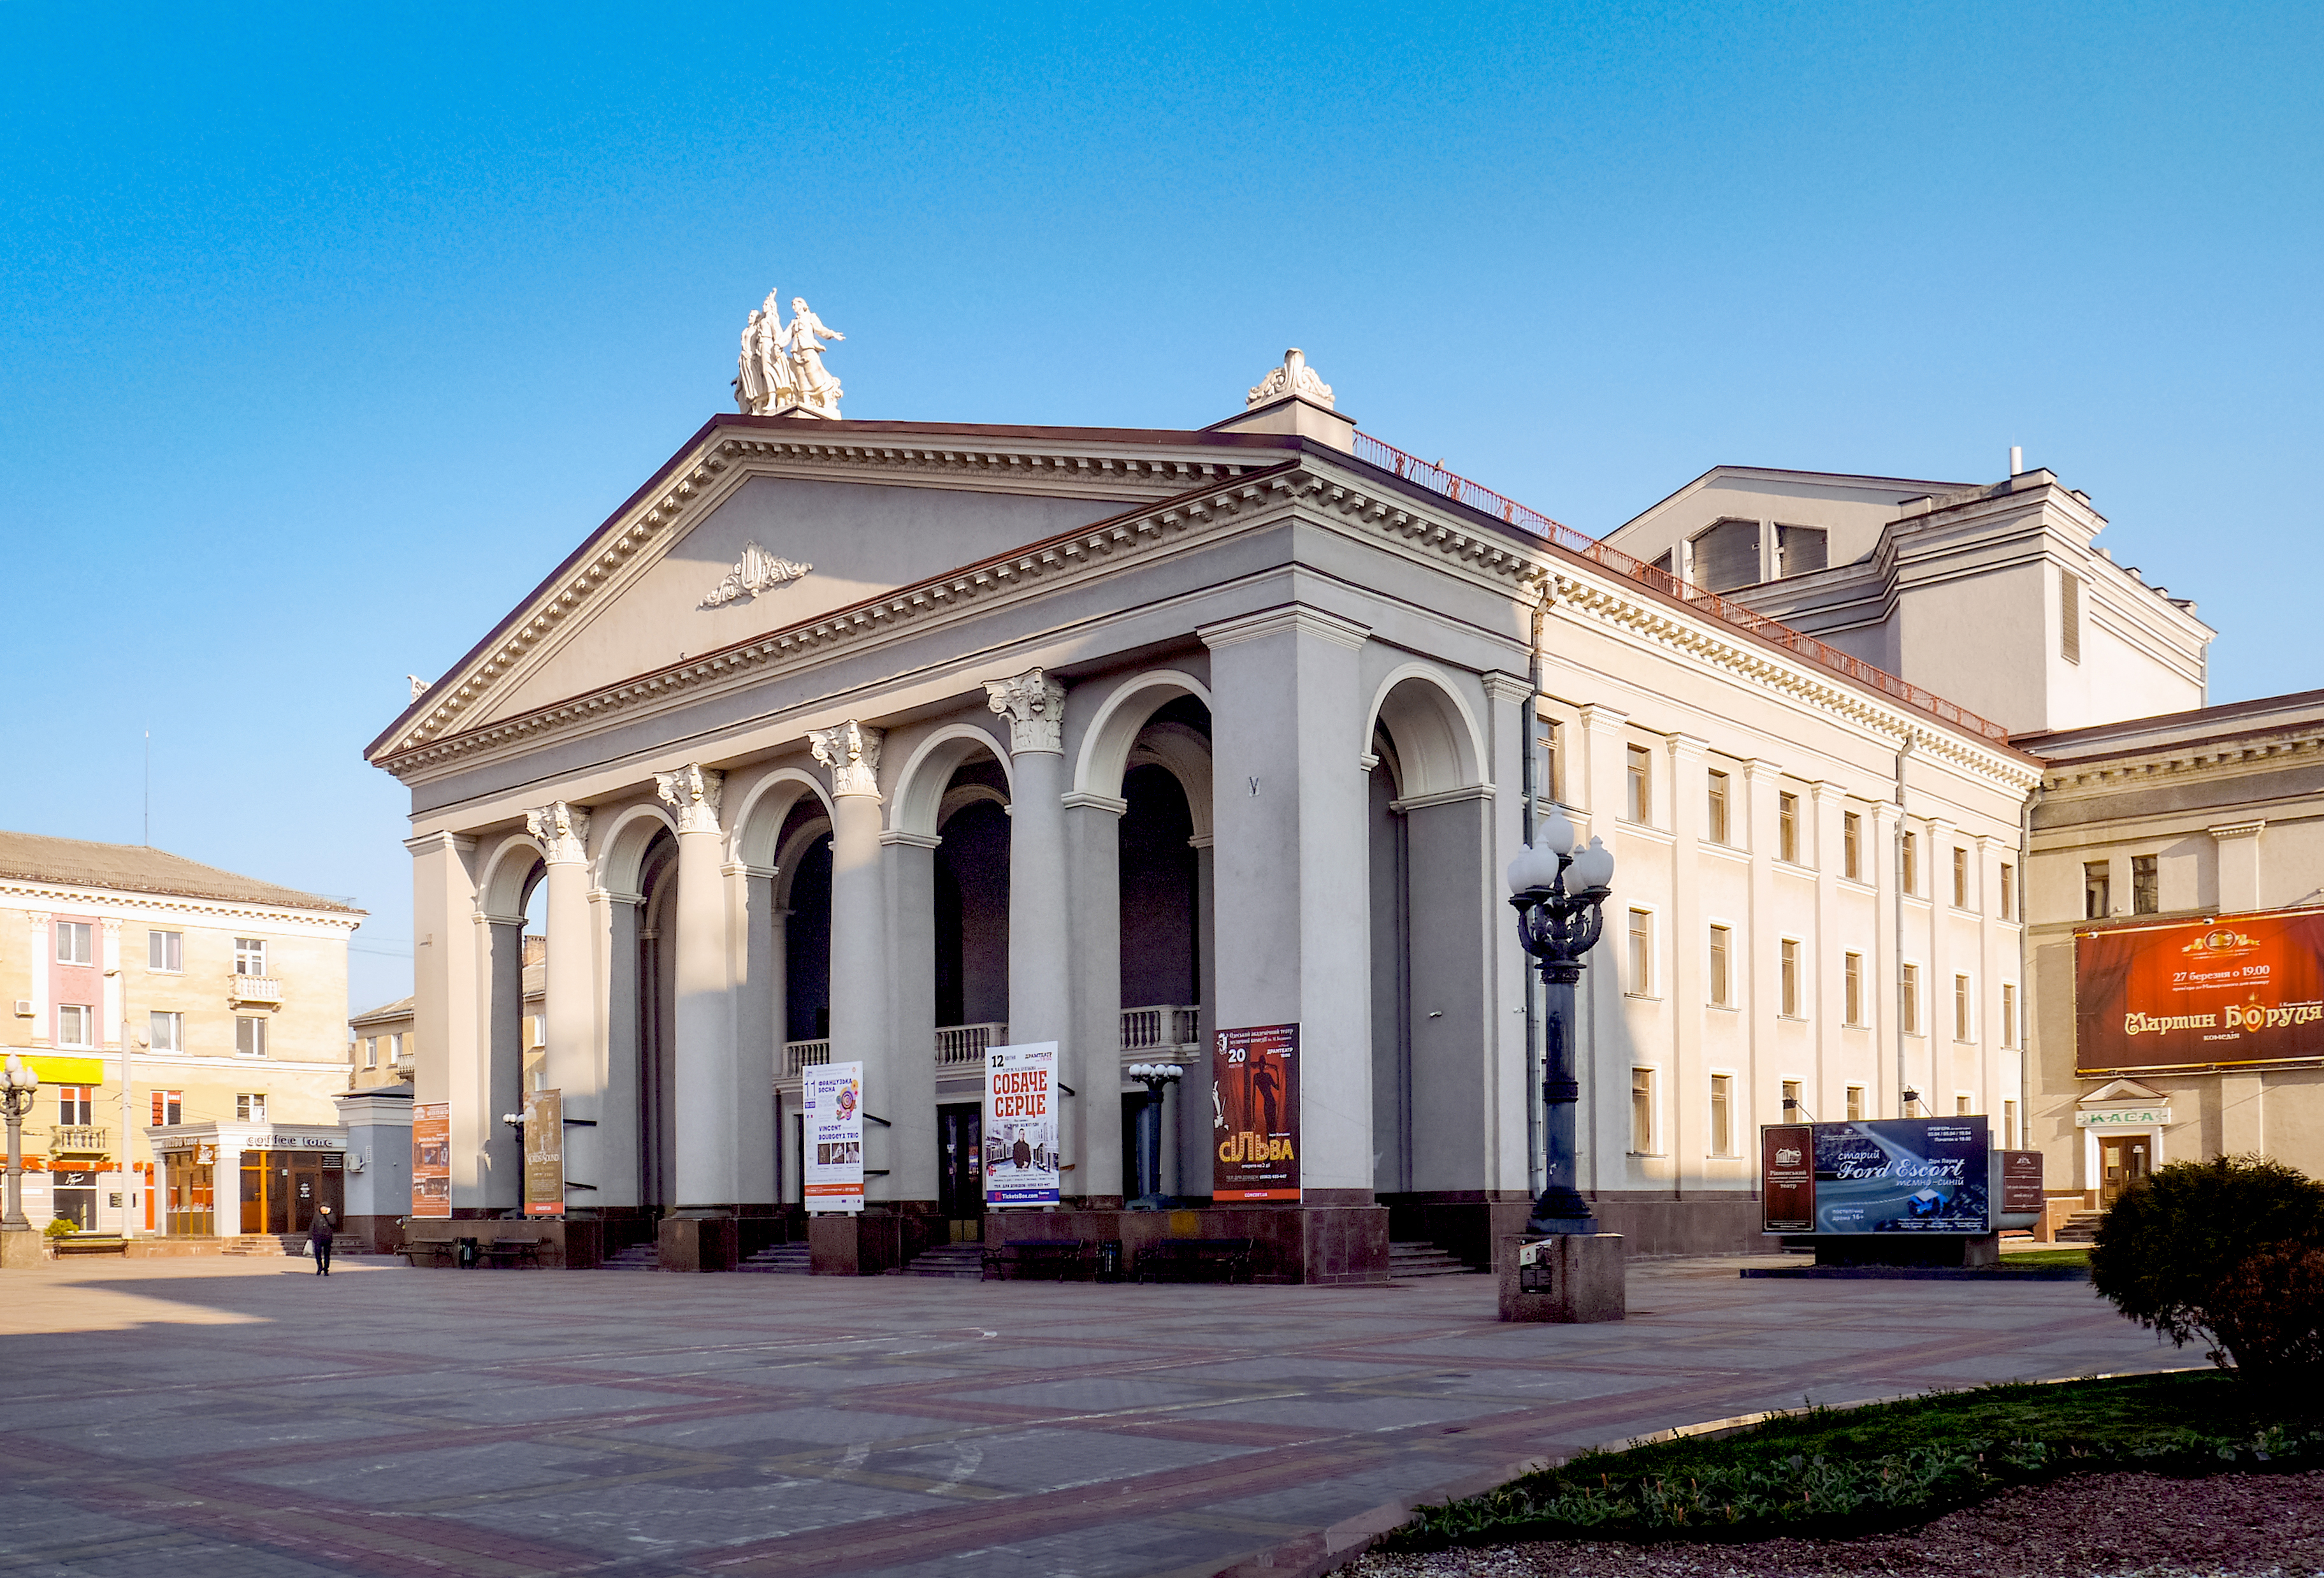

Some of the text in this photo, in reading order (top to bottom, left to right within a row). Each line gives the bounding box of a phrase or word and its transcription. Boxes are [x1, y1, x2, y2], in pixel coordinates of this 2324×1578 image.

[2173, 972, 2187, 982] 27
[2189, 971, 2230, 982] березня
[2242, 965, 2270, 976] 19.00
[2125, 1003, 2323, 1036] Мартин Боруля
[2204, 1031, 2240, 1041] комедія
[992, 1055, 1004, 1068] 12
[1228, 1048, 1246, 1063] 20
[804, 1080, 816, 1097] 11
[993, 1071, 1047, 1095] СОБАЧЕ
[995, 1094, 1046, 1118] СЕРЦЕ
[2090, 1112, 2154, 1123] КАСА
[247, 1134, 333, 1147] coffee tone
[1219, 1131, 1294, 1162] СІЛЬВА
[1838, 1150, 1880, 1161] старий
[1837, 1158, 1965, 1179] Ford Escort
